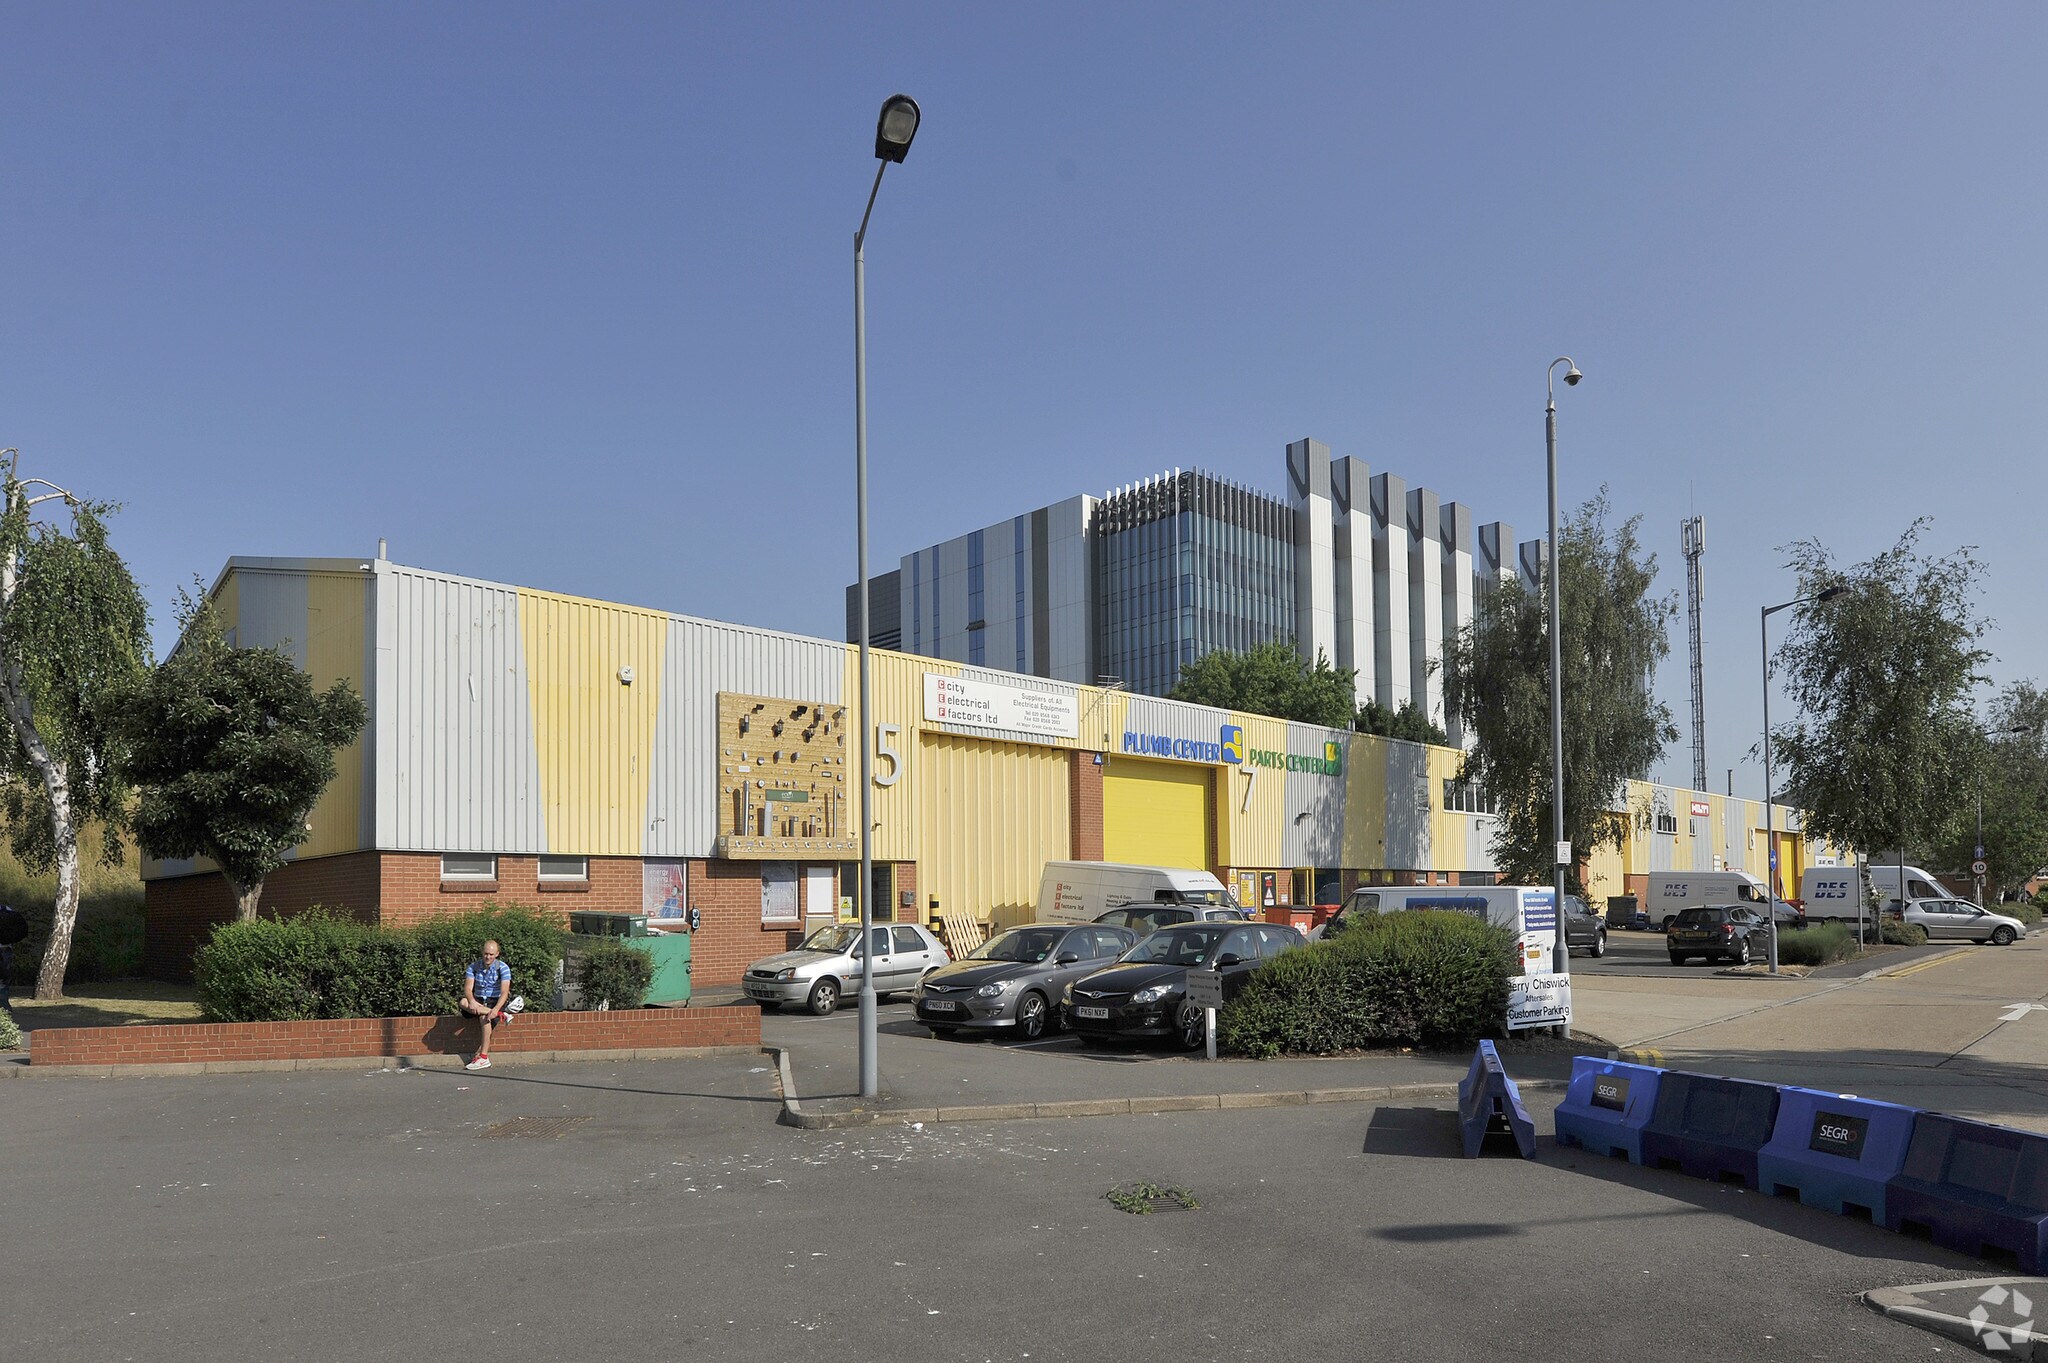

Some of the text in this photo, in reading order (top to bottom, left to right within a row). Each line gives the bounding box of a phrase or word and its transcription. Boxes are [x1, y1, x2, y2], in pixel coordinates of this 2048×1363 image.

[938, 680, 965, 695] C city
[939, 694, 990, 710] E electrical
[1021, 692, 1047, 703] Suppliers
[1013, 699, 1071, 714] Electrical Equipments
[939, 708, 998, 724] F factors ltd
[1124, 731, 1220, 761] PLUMB CENTER
[876, 722, 903, 786] 5
[1250, 748, 1324, 775] PARTS CENTER
[1241, 766, 1258, 812] 7
[1231, 888, 1237, 897] 5
[1664, 884, 1688, 897] DES
[1815, 882, 1848, 898] DES
[1532, 977, 1570, 990] Chiswick
[928, 1000, 942, 1009] PN60
[1525, 994, 1554, 1002] Aftersales
[1080, 1008, 1107, 1017] PK61 NXF
[1509, 1004, 1570, 1020] Customer Parking
[1819, 1124, 1858, 1142] SEGRO
